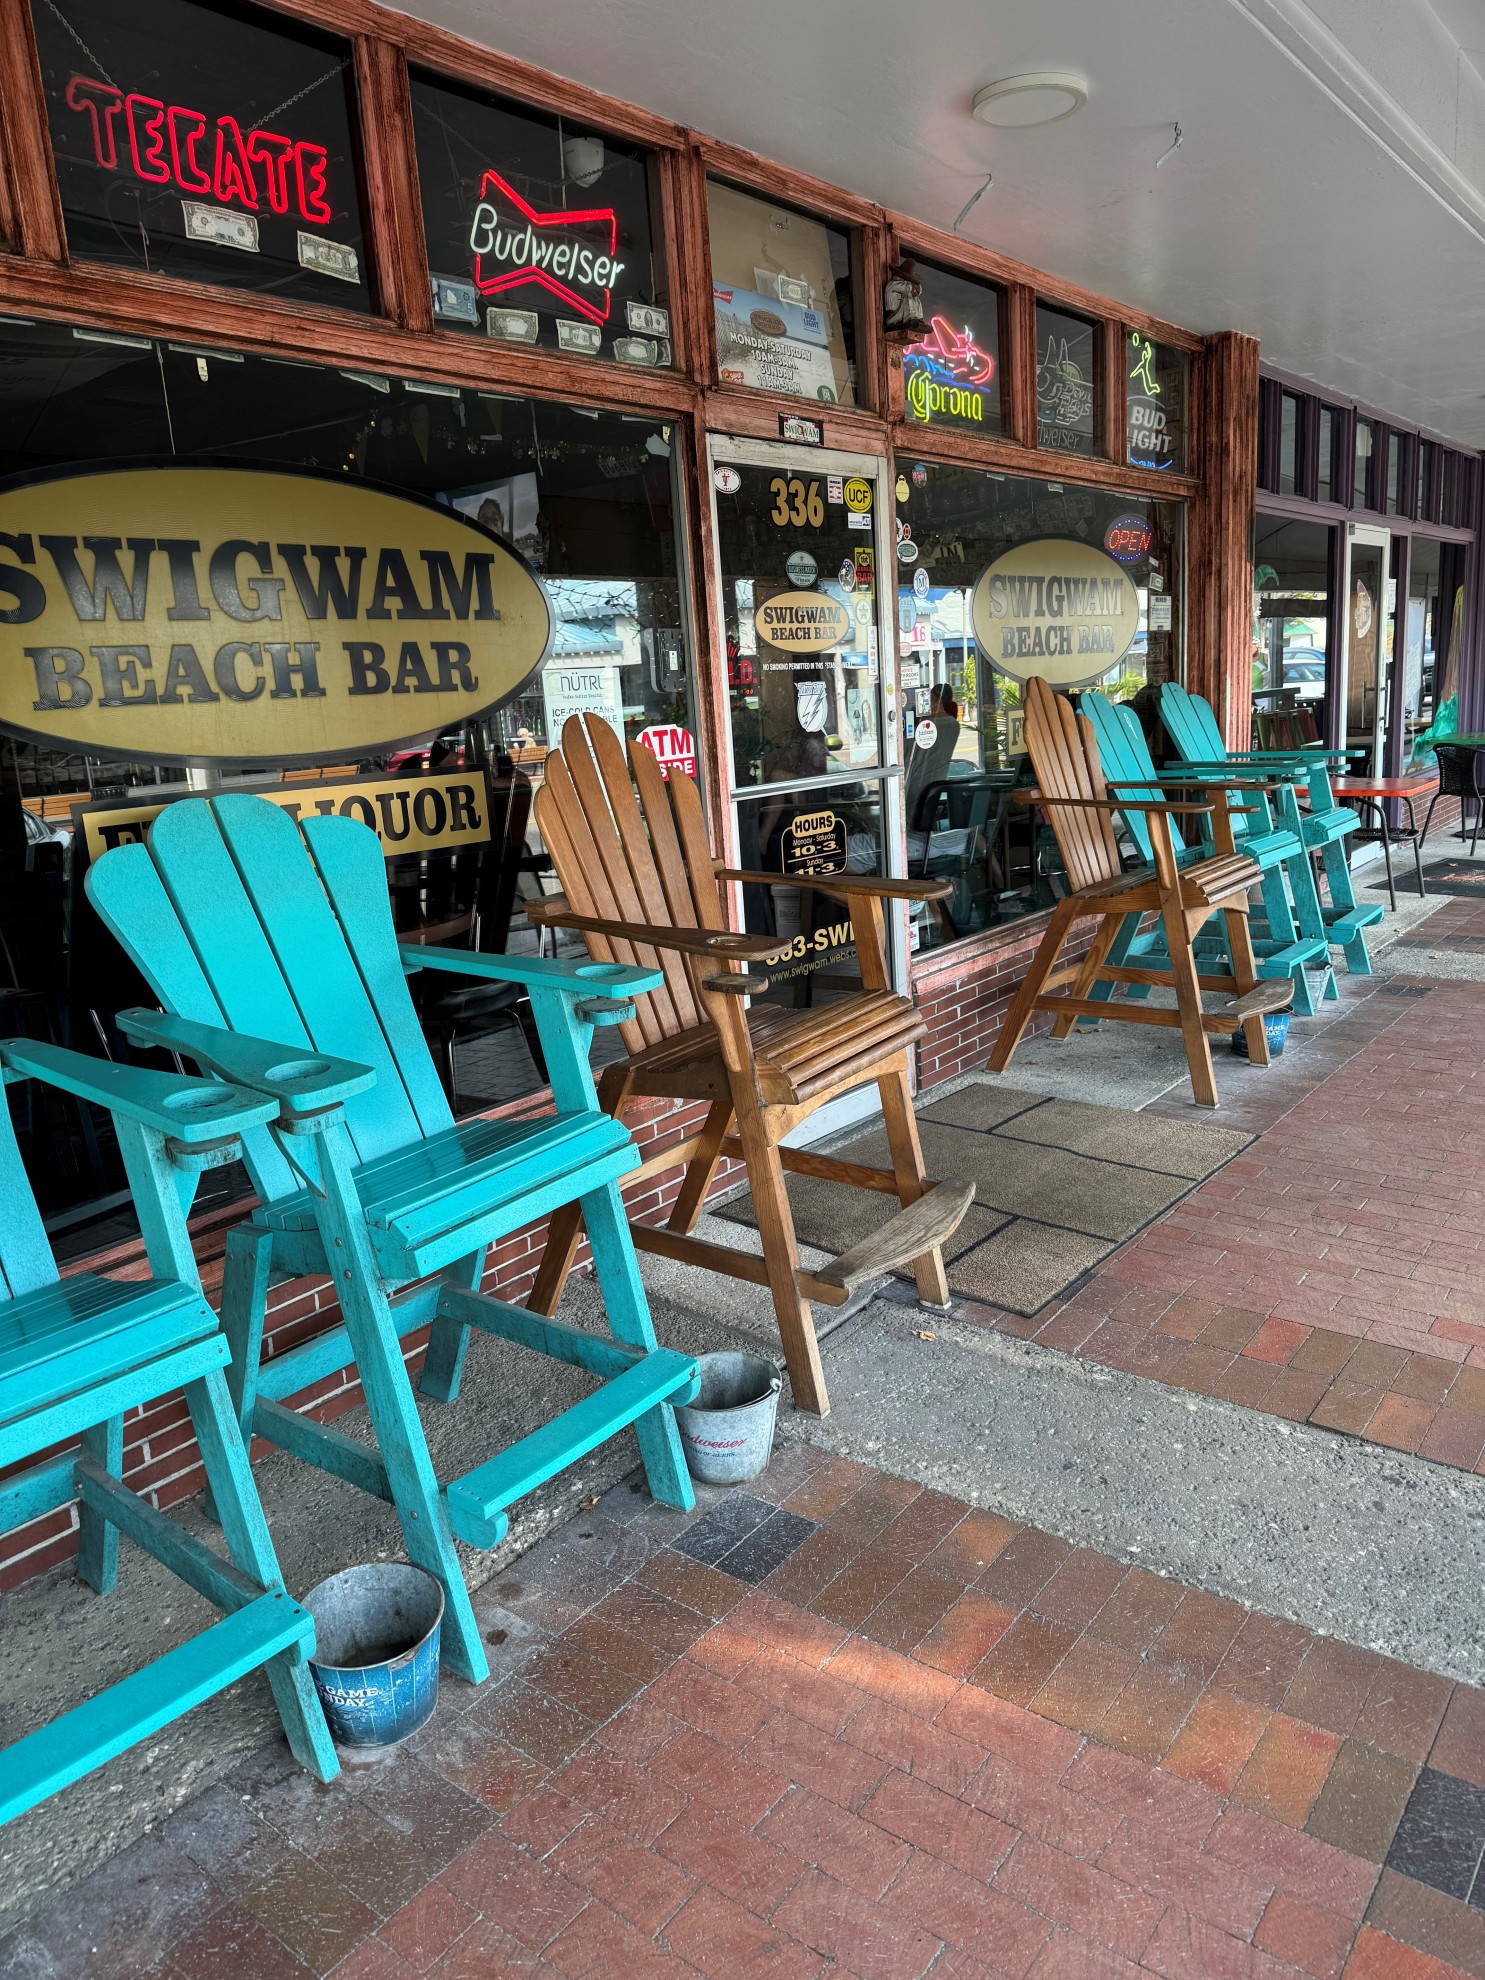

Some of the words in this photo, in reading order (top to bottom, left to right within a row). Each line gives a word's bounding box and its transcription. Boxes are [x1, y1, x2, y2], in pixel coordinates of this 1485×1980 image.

[66, 75, 331, 224] TECATE
[759, 364, 794, 381] SUNDAY
[908, 369, 983, 423] Corona
[1130, 405, 1166, 430] BUD
[1131, 428, 1172, 453] IGHT
[769, 476, 825, 528] 336
[848, 488, 869, 504] UCF
[1108, 530, 1152, 552] OPEN
[989, 574, 1124, 619] SWIGWAM
[763, 606, 842, 624] SWIGWAM
[771, 627, 812, 641] BEACH
[814, 627, 837, 640] BAR
[1001, 625, 1073, 659] BEACH
[1077, 624, 1114, 654] BAR
[23, 641, 327, 711] BEACH
[341, 641, 479, 696] BAR
[762, 663, 769, 671] NO
[770, 663, 788, 671] SMOKING
[788, 662, 810, 671] PERMITTED
[641, 728, 691, 758] ATM
[794, 815, 833, 834] HOURS
[816, 833, 837, 843] Saturday
[806, 858, 824, 867] Sunday
[325, 1685, 379, 1699] GAME
